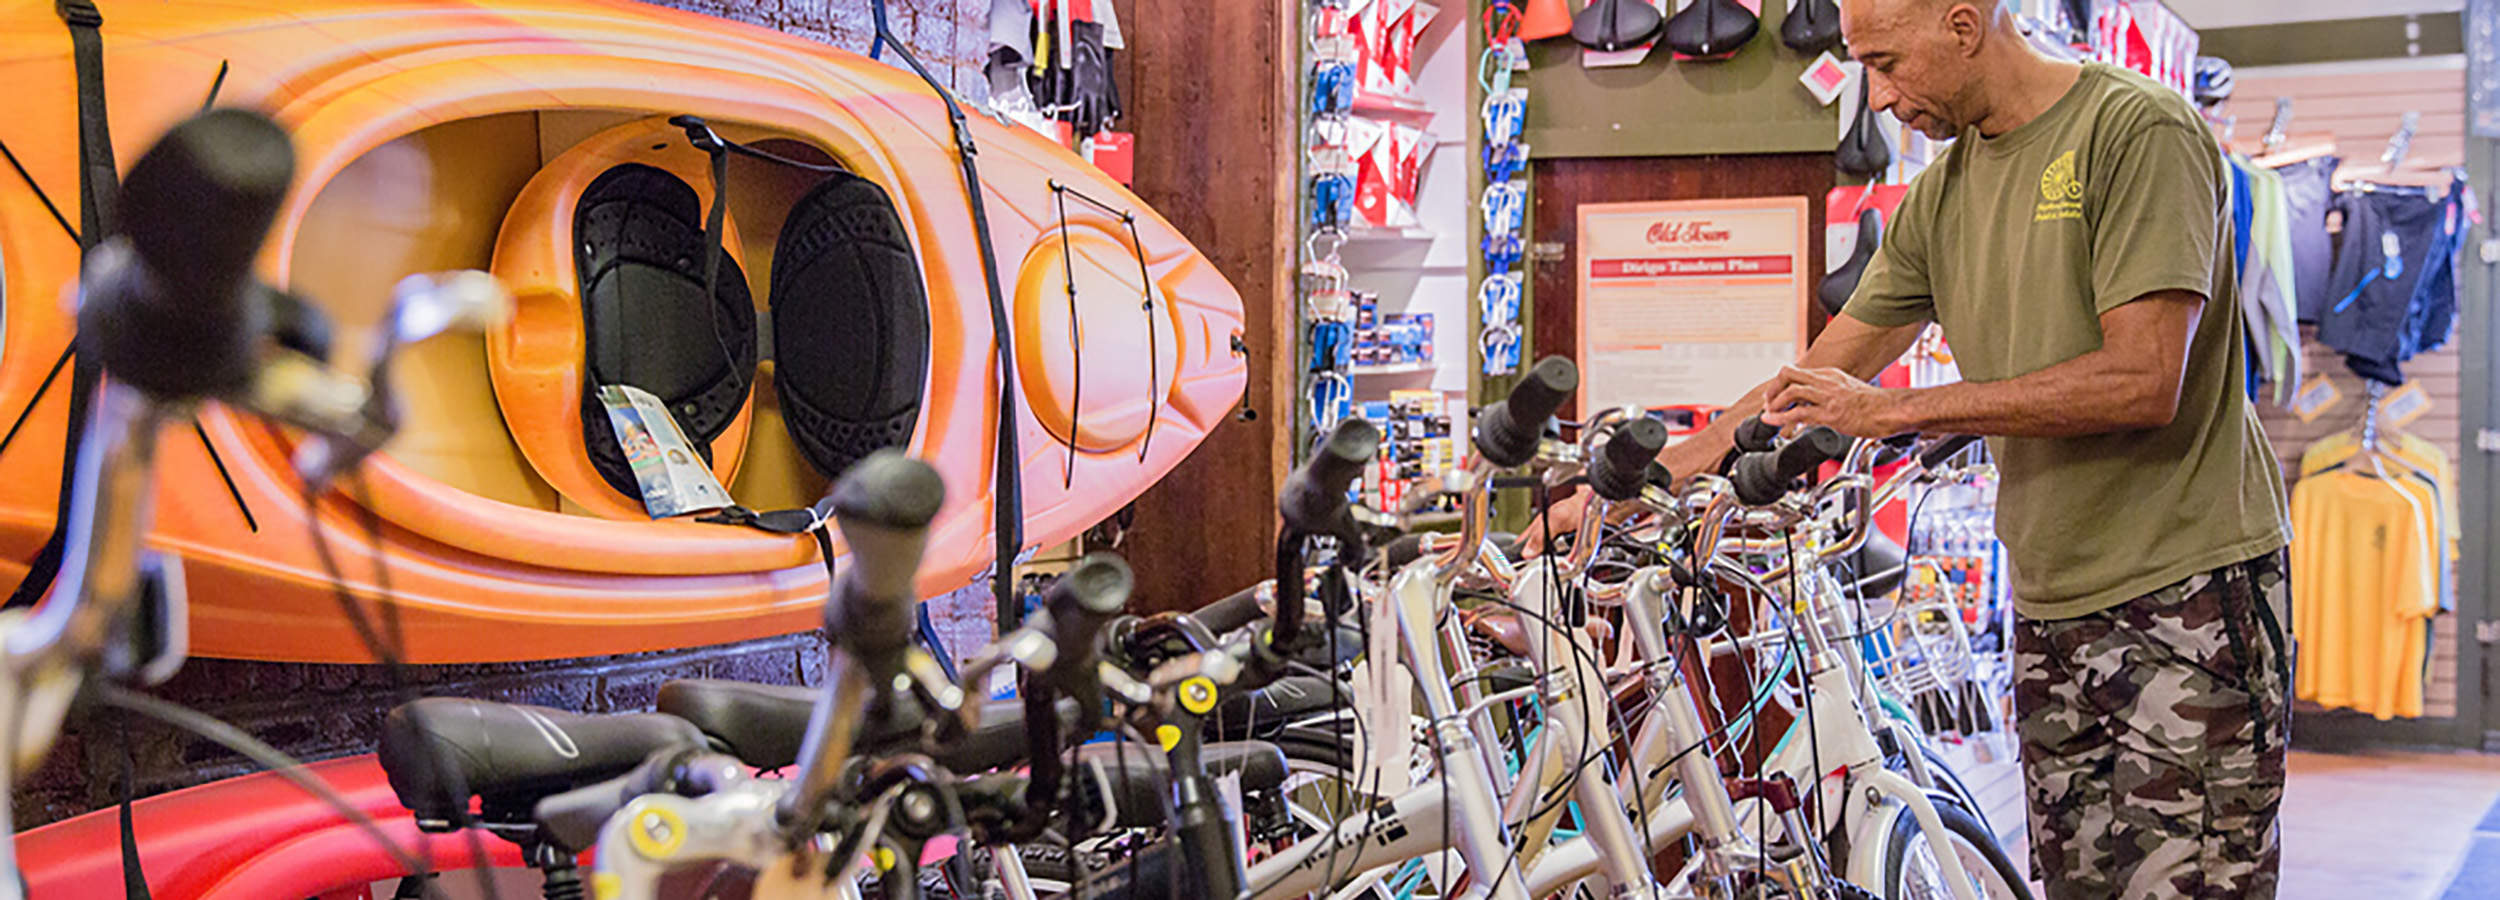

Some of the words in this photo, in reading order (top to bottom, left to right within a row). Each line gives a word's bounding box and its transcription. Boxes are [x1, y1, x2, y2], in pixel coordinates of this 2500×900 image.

[1646, 221, 1682, 243] Old
[1683, 221, 1730, 242] Town
[1623, 260, 1666, 276] Dirigo
[1670, 259, 1725, 273] Tandem
[1729, 258, 1760, 271] Plus
